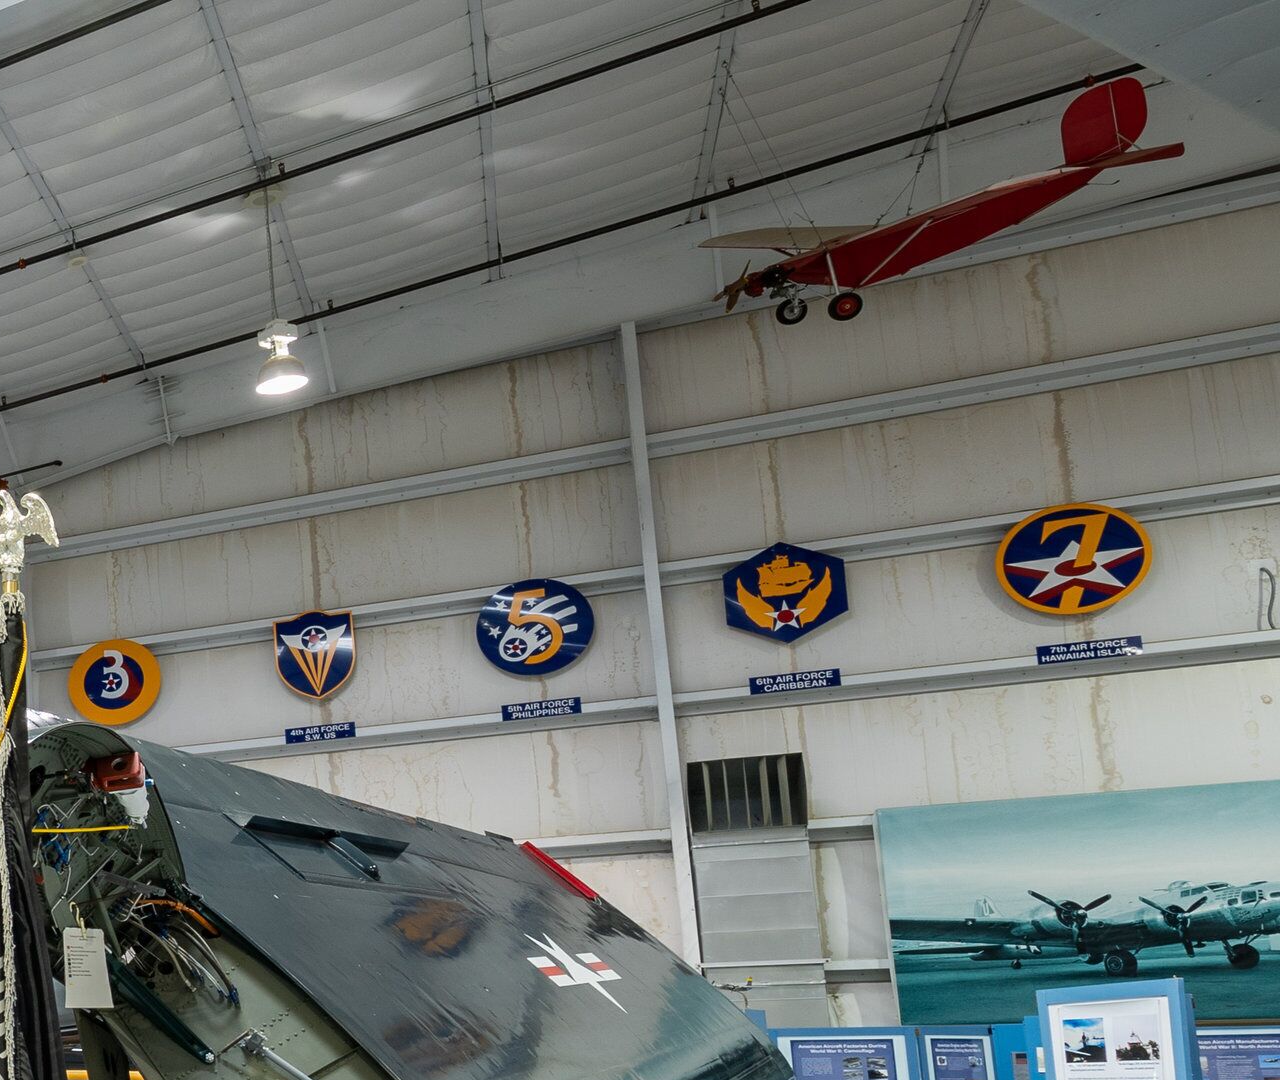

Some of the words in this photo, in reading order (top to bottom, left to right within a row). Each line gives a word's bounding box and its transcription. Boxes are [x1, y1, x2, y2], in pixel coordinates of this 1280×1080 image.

[1040, 513, 1110, 613] 7
[508, 588, 564, 666] 5
[1050, 645, 1067, 654] 7th
[1069, 643, 1088, 652] AIR
[1089, 639, 1128, 650] FORCE
[1041, 650, 1095, 662] HAWAIIAN
[101, 650, 129, 699] 3
[756, 677, 773, 686] 6th
[775, 674, 793, 684] AIR
[796, 670, 834, 681] FORCE
[764, 679, 827, 692] CARIBBEAN
[507, 705, 522, 713] 5th
[524, 703, 540, 711] AIR
[542, 698, 575, 709] FORCE
[305, 727, 320, 735] AIR
[320, 723, 350, 733] FORCE
[304, 733, 323, 742] S.W.
